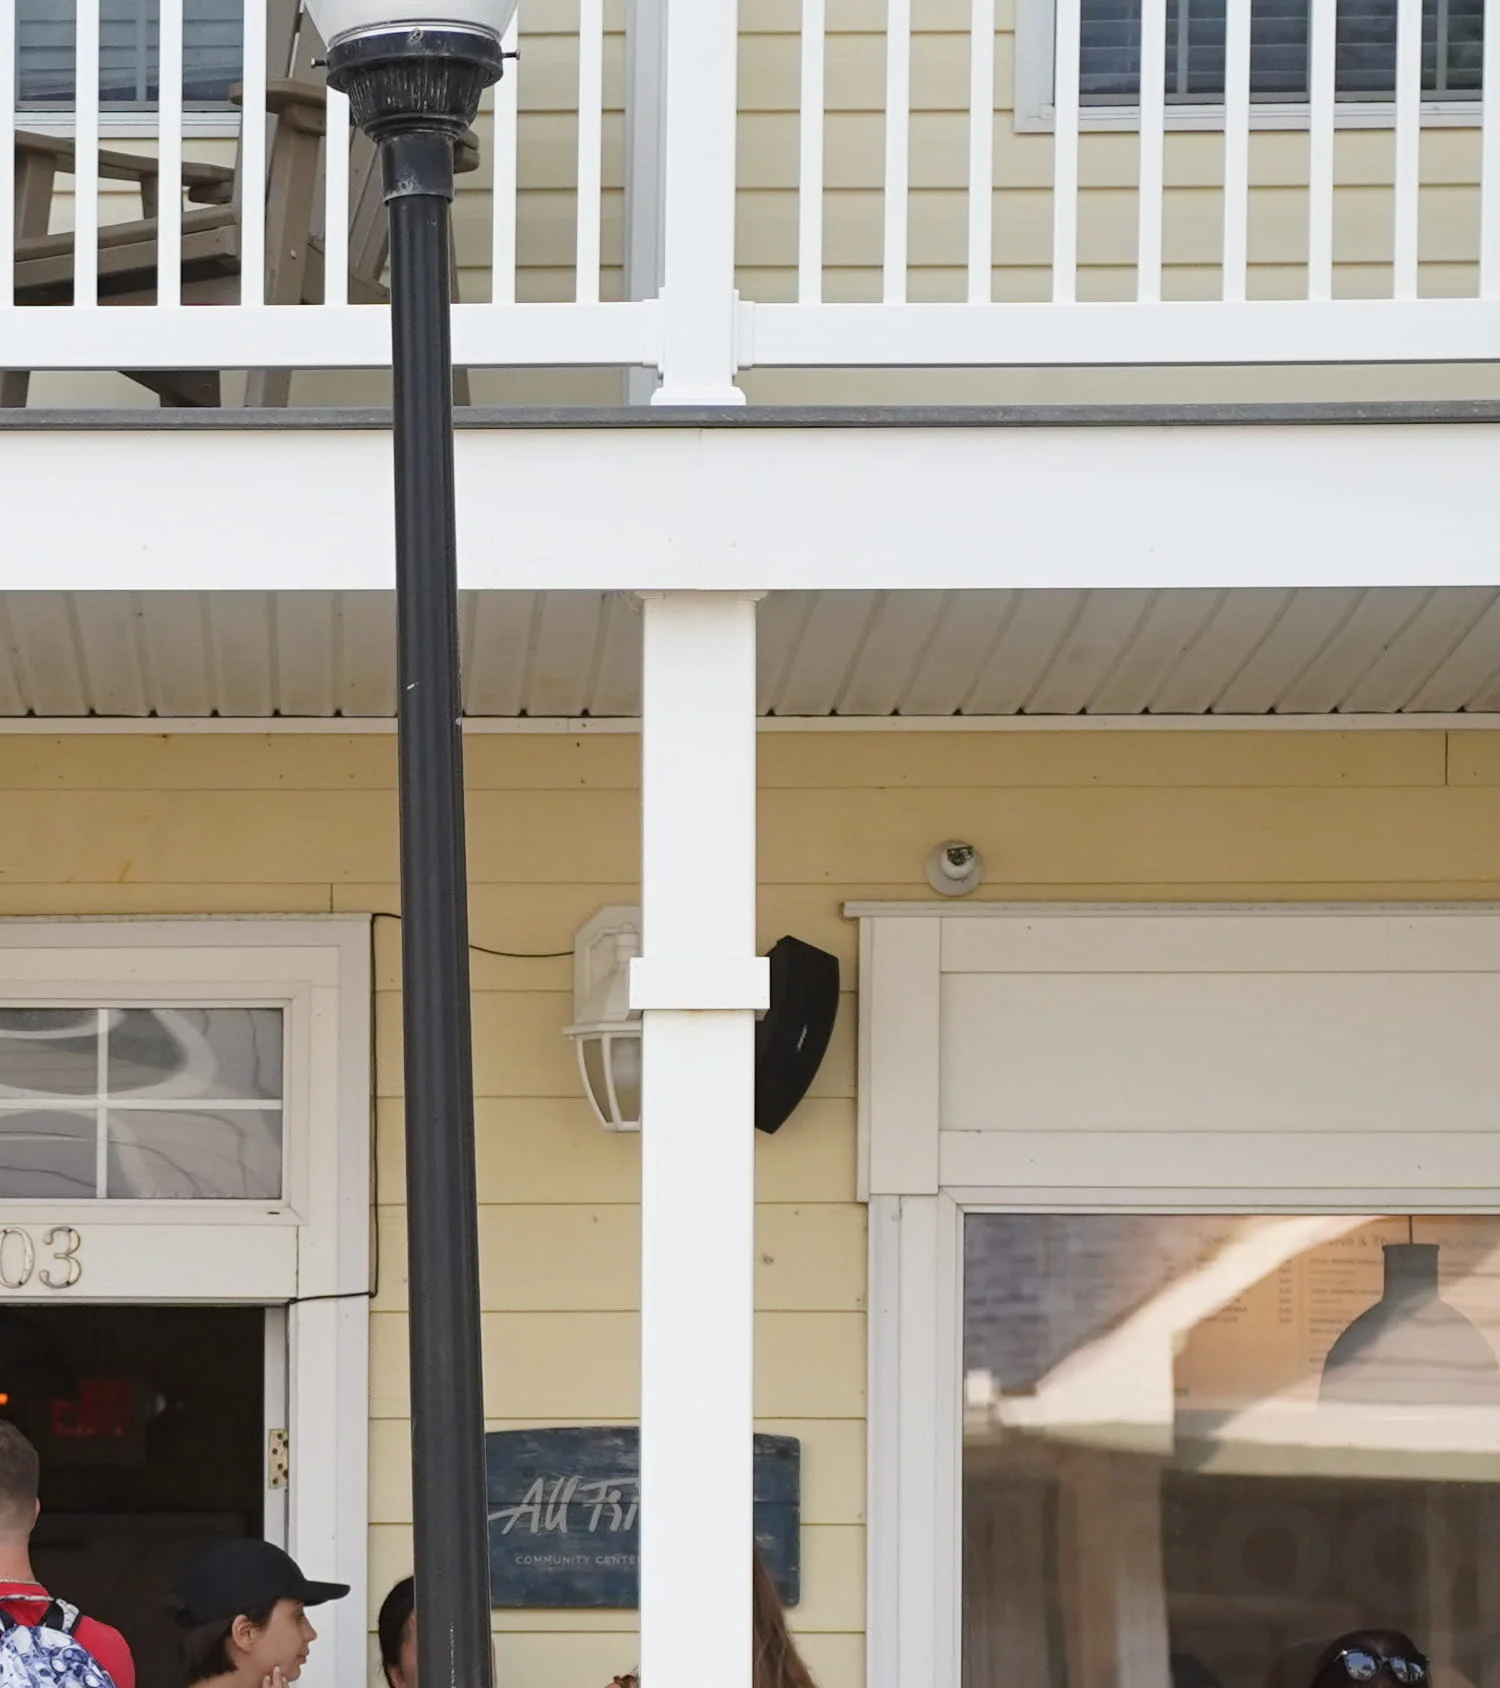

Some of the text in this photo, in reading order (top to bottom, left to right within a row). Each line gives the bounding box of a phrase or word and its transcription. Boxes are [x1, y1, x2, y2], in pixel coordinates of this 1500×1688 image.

[487, 1475, 584, 1535] All
[514, 1554, 641, 1567] COMMUNITY CENTE
